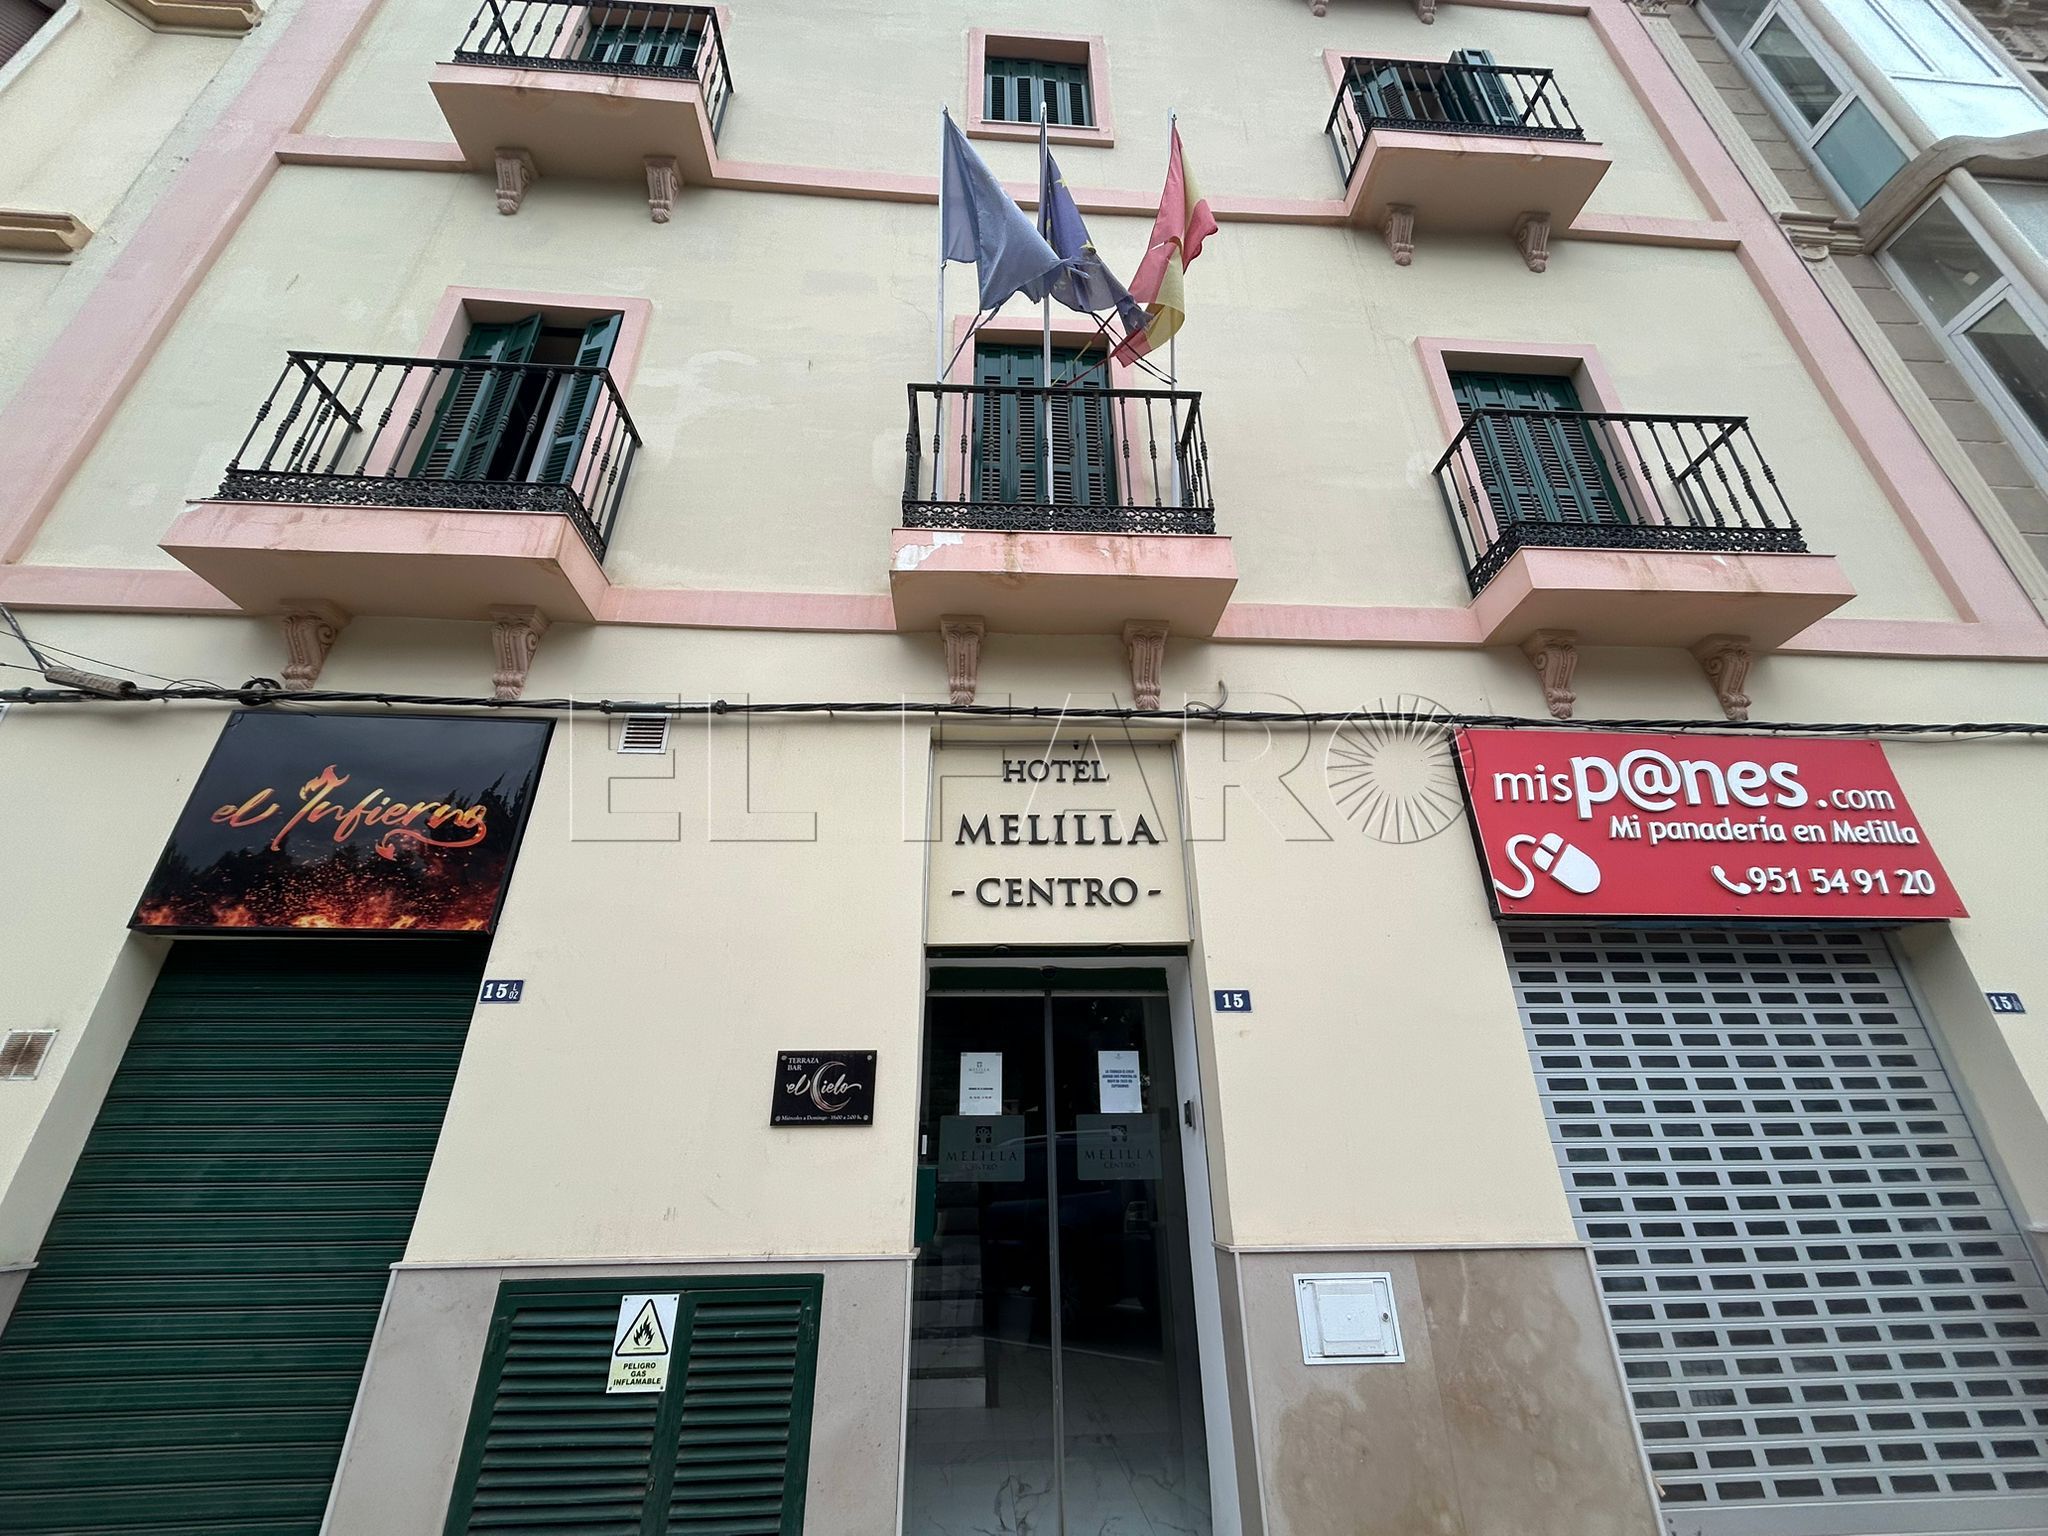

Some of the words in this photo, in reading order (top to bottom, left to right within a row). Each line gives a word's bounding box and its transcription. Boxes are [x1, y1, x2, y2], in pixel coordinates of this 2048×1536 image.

[1003, 759, 1110, 783] HOTEL
[211, 788, 281, 828] el
[271, 764, 488, 860] Infierno
[955, 813, 1160, 845] MELILLA
[1609, 813, 1641, 840] Mi
[1647, 815, 1787, 846] panadería
[1792, 821, 1826, 843] en
[1831, 819, 1920, 845] Melilla
[1746, 866, 1802, 893] 951
[1808, 868, 1849, 894] 54
[1851, 868, 1890, 895] 91
[1894, 868, 1936, 896] 20
[483, 983, 509, 999] 15
[1222, 993, 1244, 1009] 15
[1990, 995, 2012, 1010] 15
[786, 1074, 811, 1096] el
[809, 1061, 862, 1113] Cielo
[946, 1151, 1017, 1161] MELILLA
[1084, 1149, 1154, 1160] MELILLA
[623, 1362, 656, 1370] PELIGRO
[613, 1377, 662, 1386] INFLAMABLE
